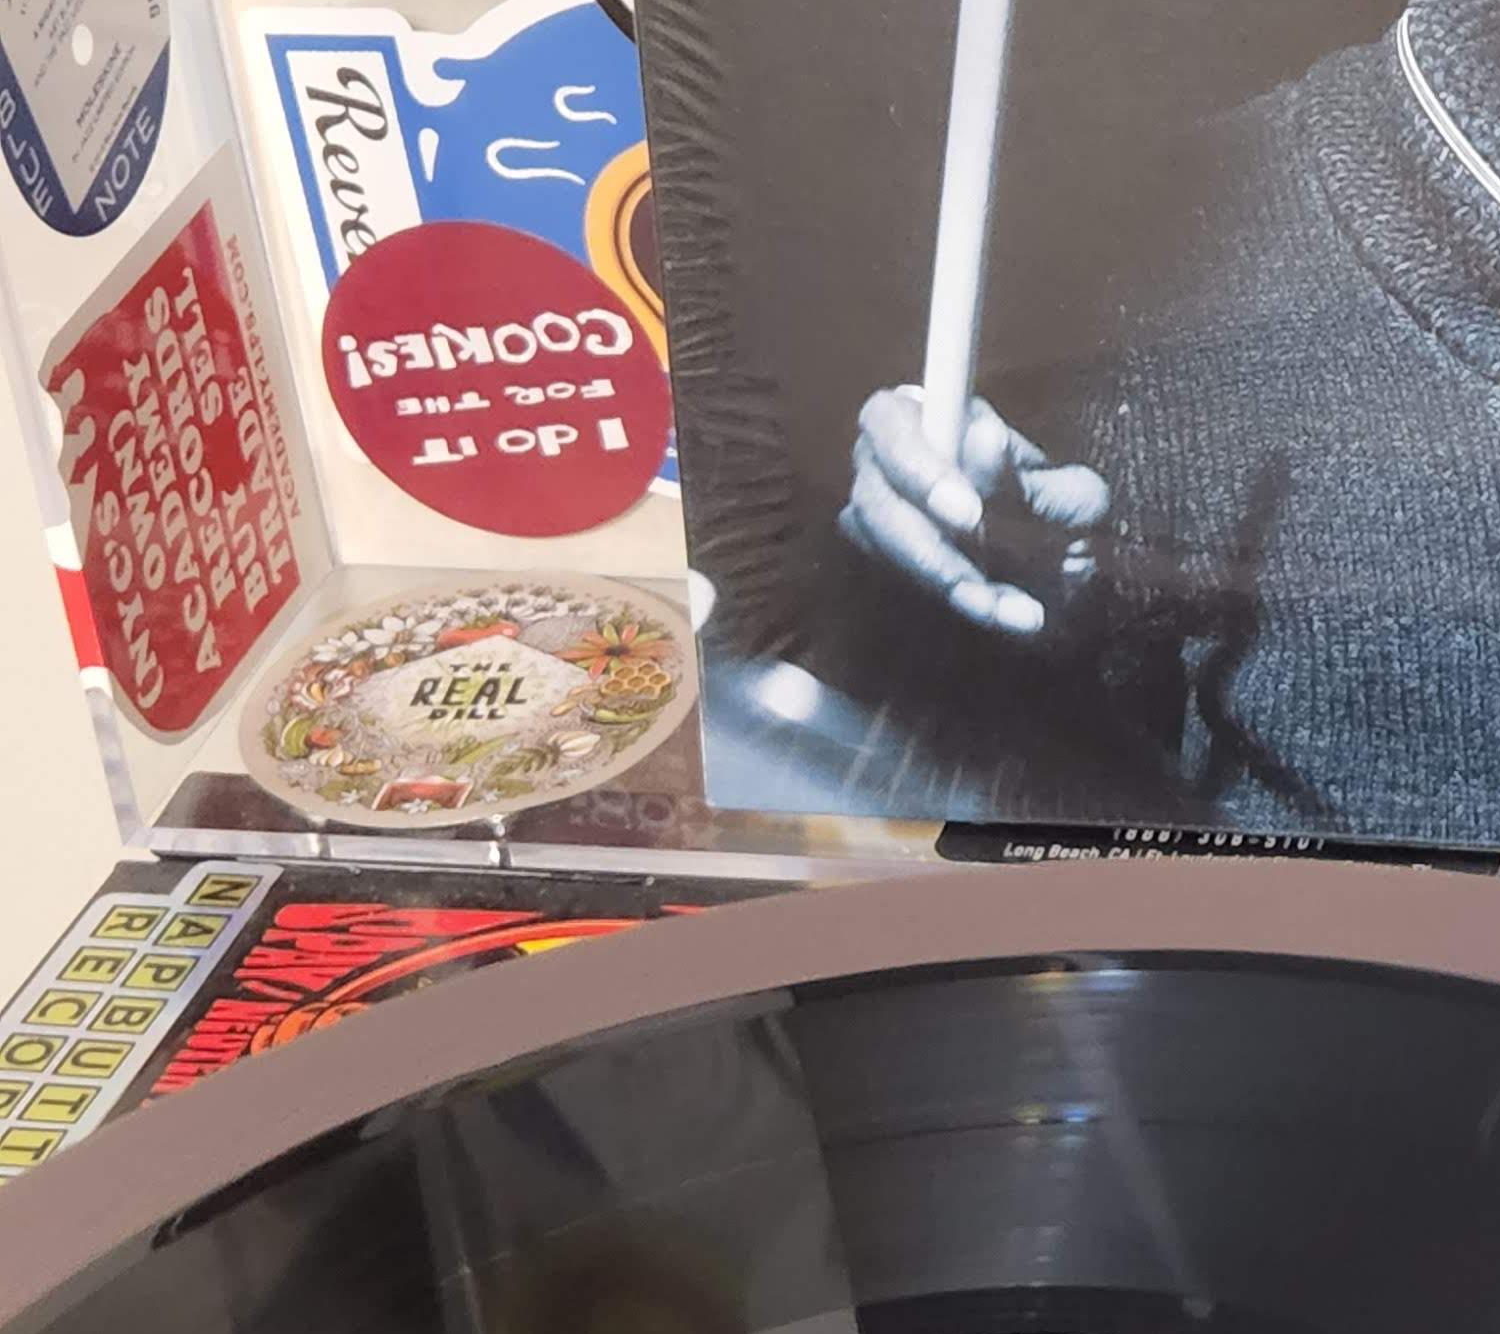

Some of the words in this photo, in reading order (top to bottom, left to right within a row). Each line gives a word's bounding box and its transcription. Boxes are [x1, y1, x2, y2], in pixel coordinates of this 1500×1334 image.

[0, 88, 54, 217] BLUE
[94, 105, 156, 222] NOTE
[173, 266, 227, 425] SELL
[338, 308, 634, 390] COOKIES!
[504, 378, 617, 405] FOR
[144, 285, 237, 610] RECORDS
[396, 391, 492, 418] THE
[121, 352, 223, 675] ACADEMY
[226, 364, 294, 586] TRADE
[220, 483, 271, 614] BUY
[409, 677, 529, 706] REAL
[426, 709, 508, 721] DILL
[449, 661, 514, 673] THE
[1003, 842, 1046, 861] Long
